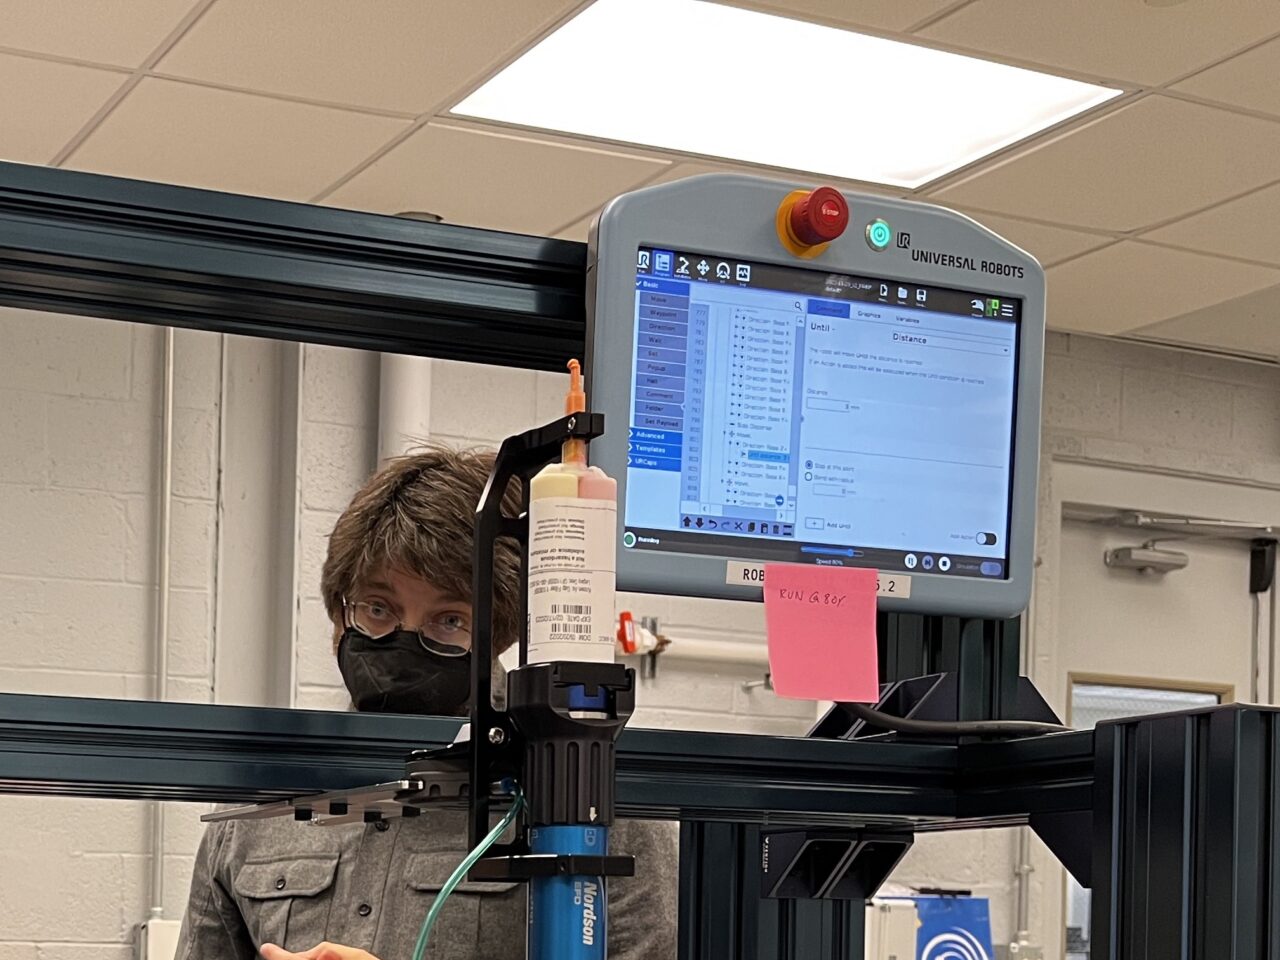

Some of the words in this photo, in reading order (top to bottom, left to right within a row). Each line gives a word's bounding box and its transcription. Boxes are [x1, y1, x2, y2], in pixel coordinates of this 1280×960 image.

[912, 249, 976, 271] UNIVERSAL
[981, 260, 1024, 279] ROBOTS
[810, 322, 830, 334] Until
[893, 333, 927, 345] Distance
[636, 431, 665, 441] Advanced
[635, 444, 665, 454] Templates
[743, 568, 765, 582] ROB
[779, 588, 804, 601] RUN
[574, 880, 582, 905] EFD
[582, 881, 598, 946] Nordson
